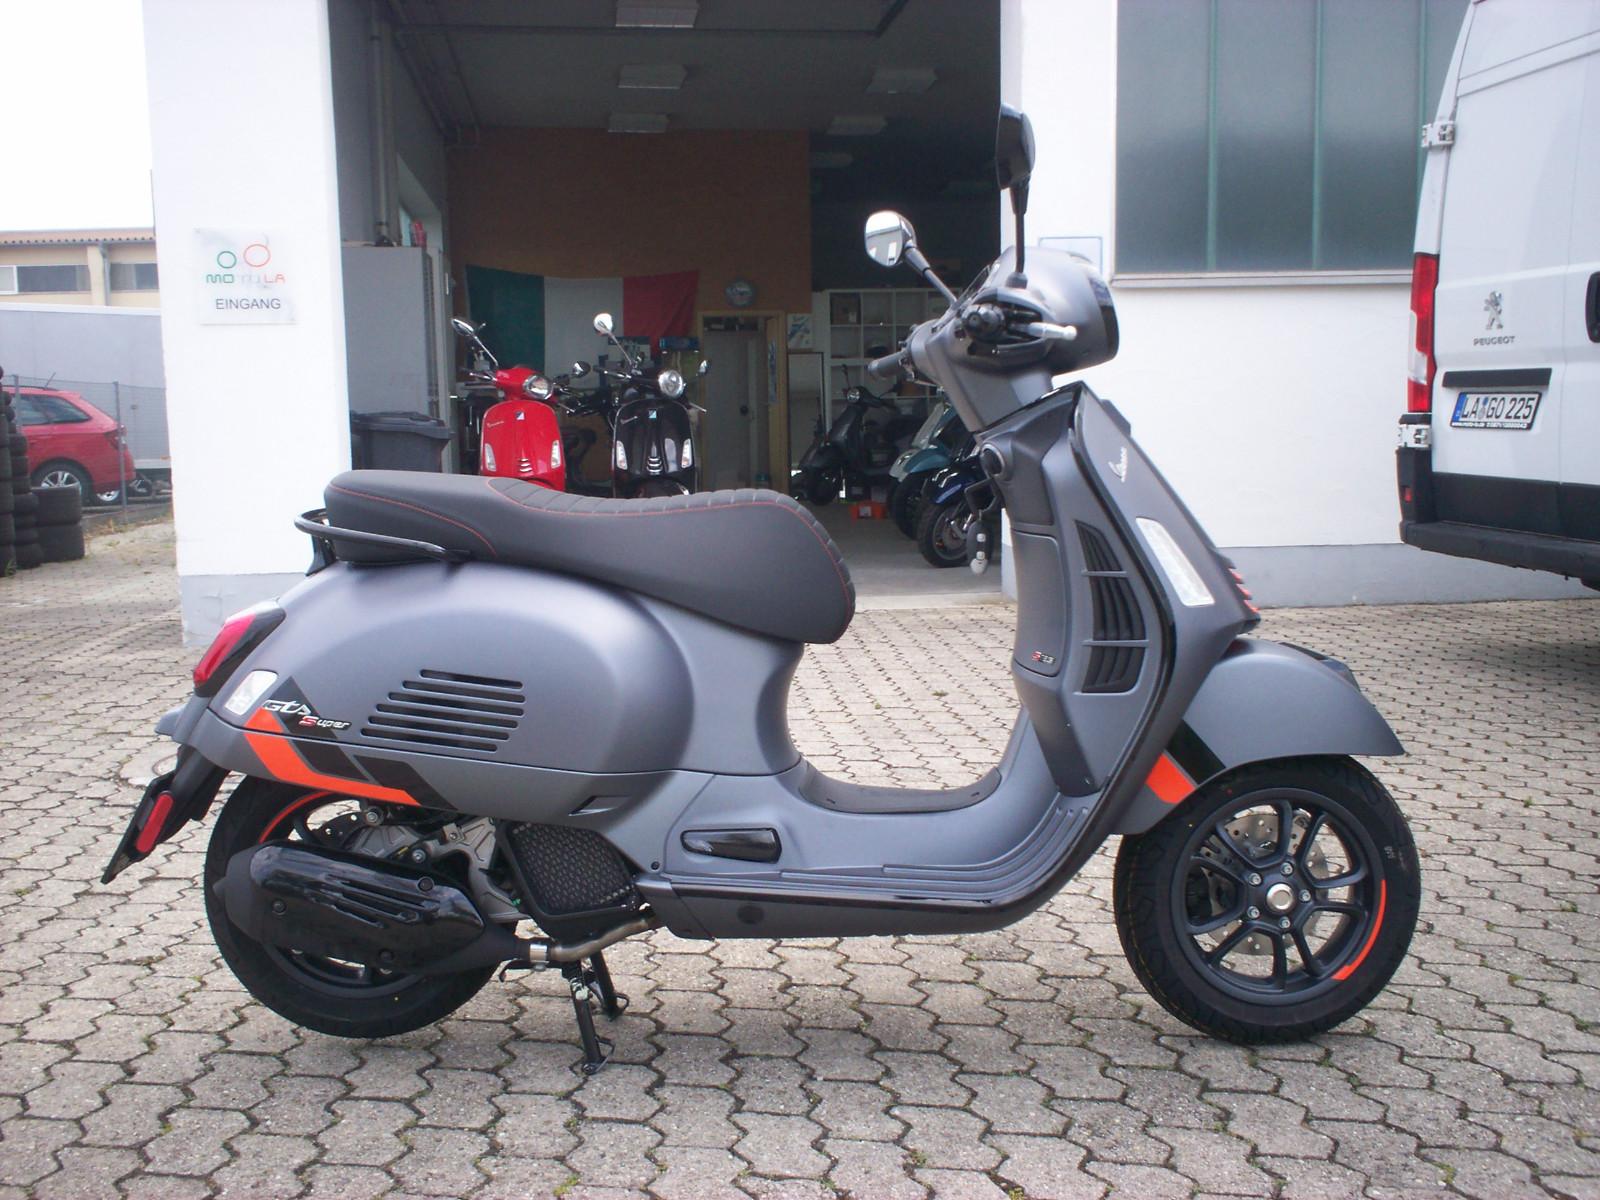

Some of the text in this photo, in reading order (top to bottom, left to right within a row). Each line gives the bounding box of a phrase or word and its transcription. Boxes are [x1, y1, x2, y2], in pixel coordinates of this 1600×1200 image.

[215, 298, 281, 310] EINGANG
[1473, 335, 1515, 346] PEUGEOT
[1505, 396, 1536, 420] 225
